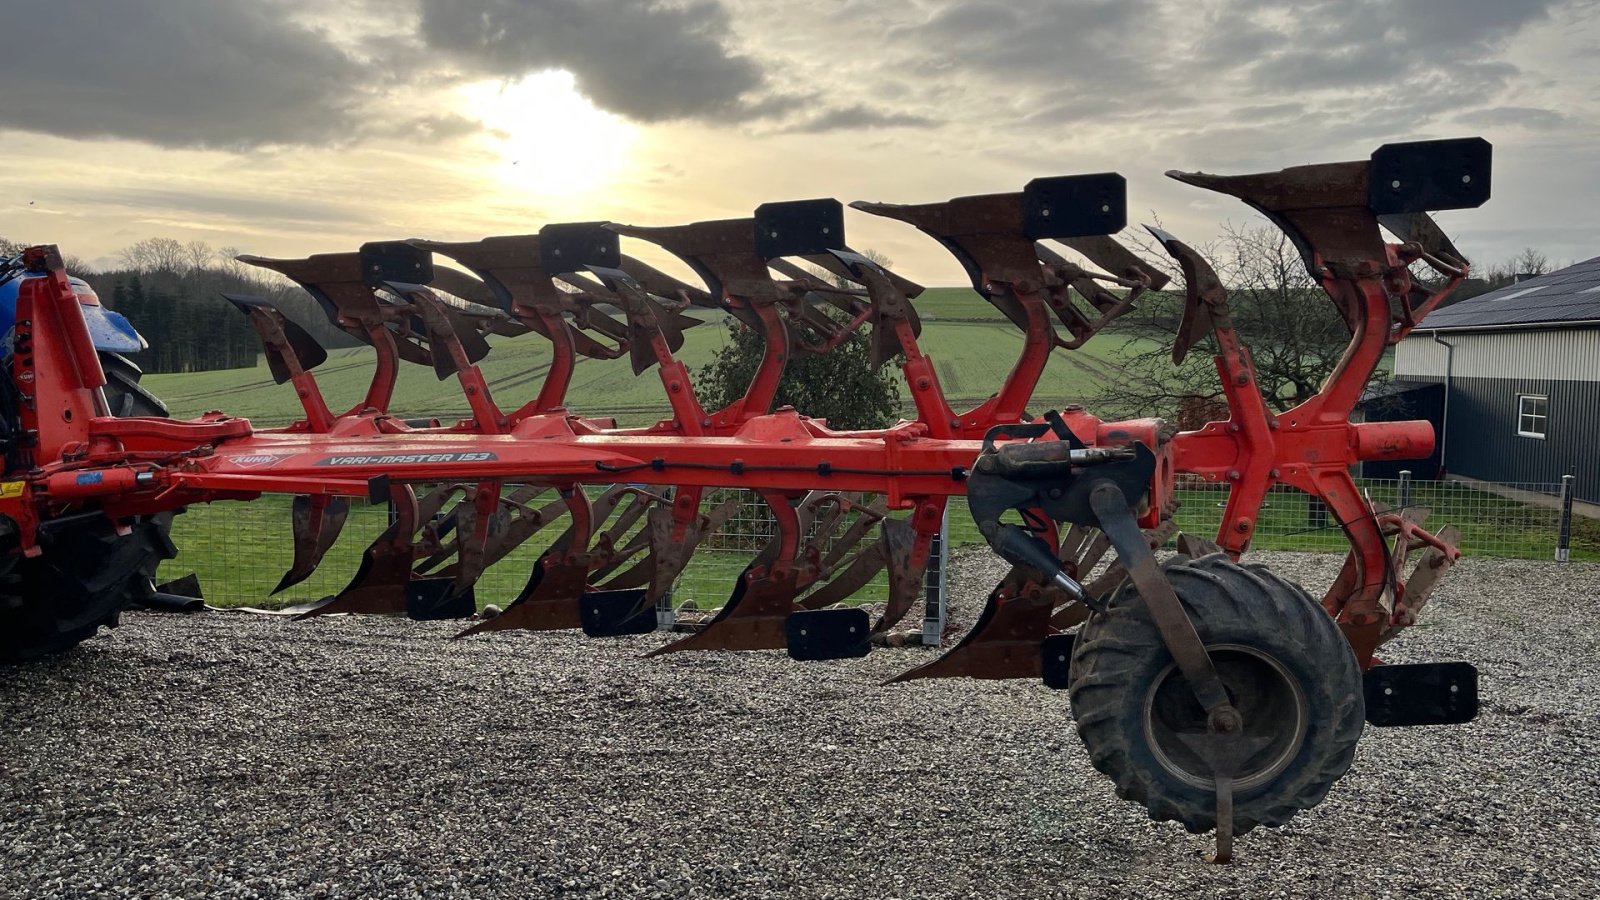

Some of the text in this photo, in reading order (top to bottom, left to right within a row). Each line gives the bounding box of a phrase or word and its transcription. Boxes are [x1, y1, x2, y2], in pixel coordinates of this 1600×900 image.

[234, 455, 273, 464] KUHN
[330, 452, 491, 465] VARI-MASTER 153
